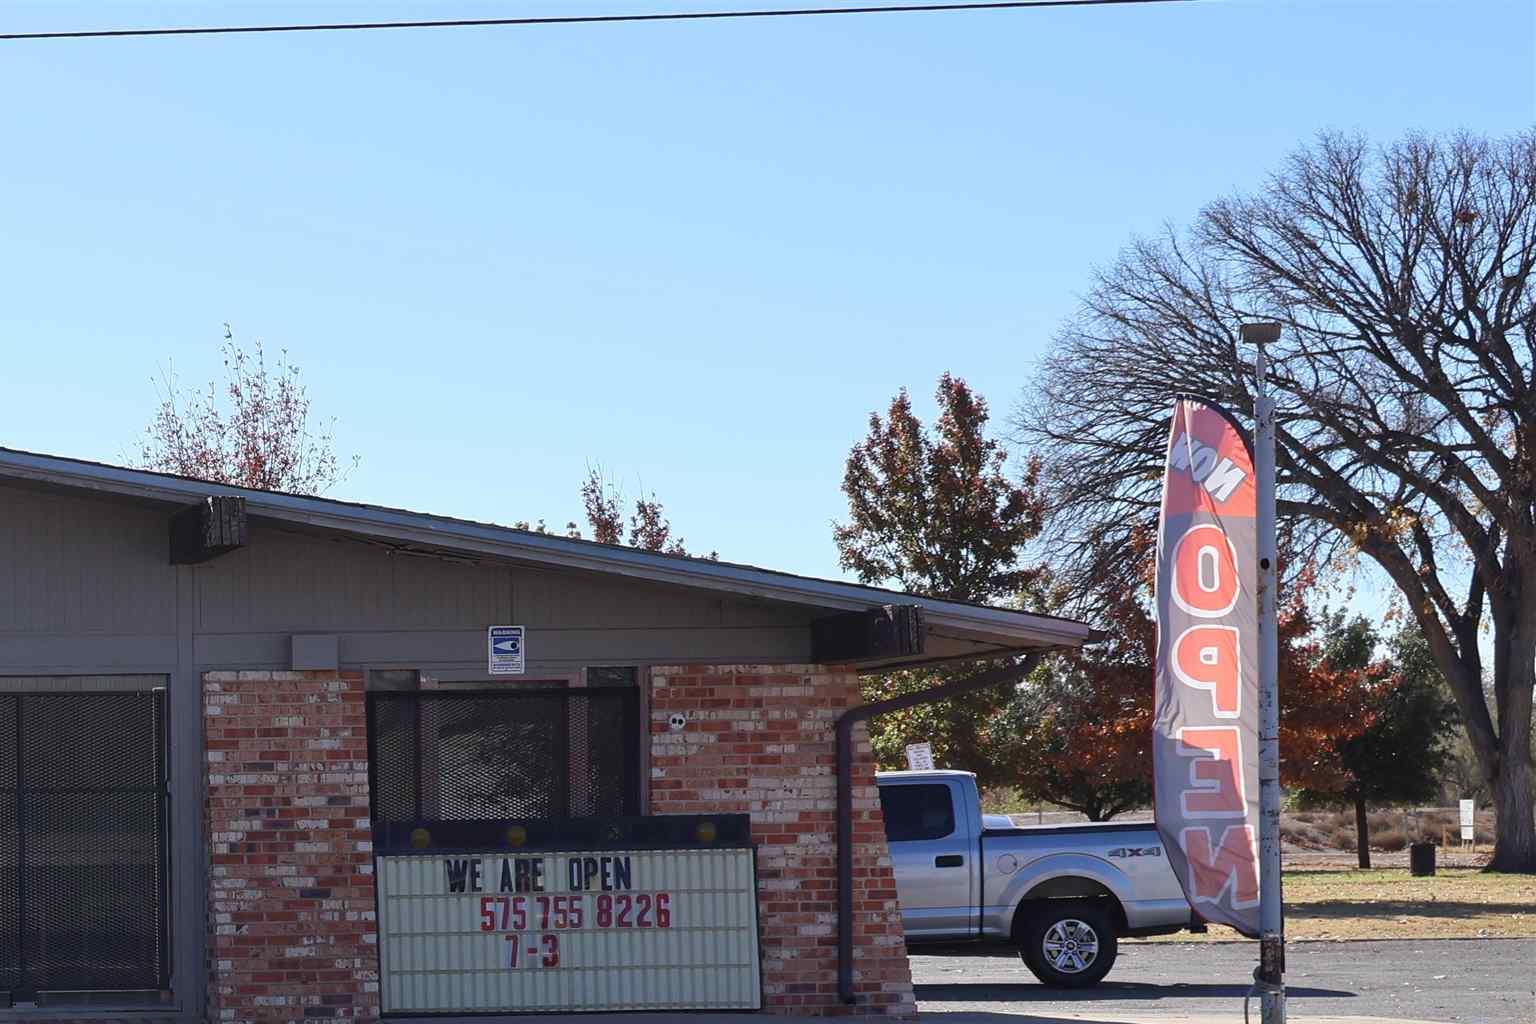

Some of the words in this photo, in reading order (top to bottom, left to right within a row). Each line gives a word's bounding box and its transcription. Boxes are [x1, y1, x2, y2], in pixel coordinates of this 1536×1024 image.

[446, 857, 482, 893] WE
[500, 857, 545, 893] ARE
[569, 856, 632, 892] OPEN
[480, 896, 526, 931] 575
[536, 895, 583, 930] 755
[596, 893, 672, 929] 8226
